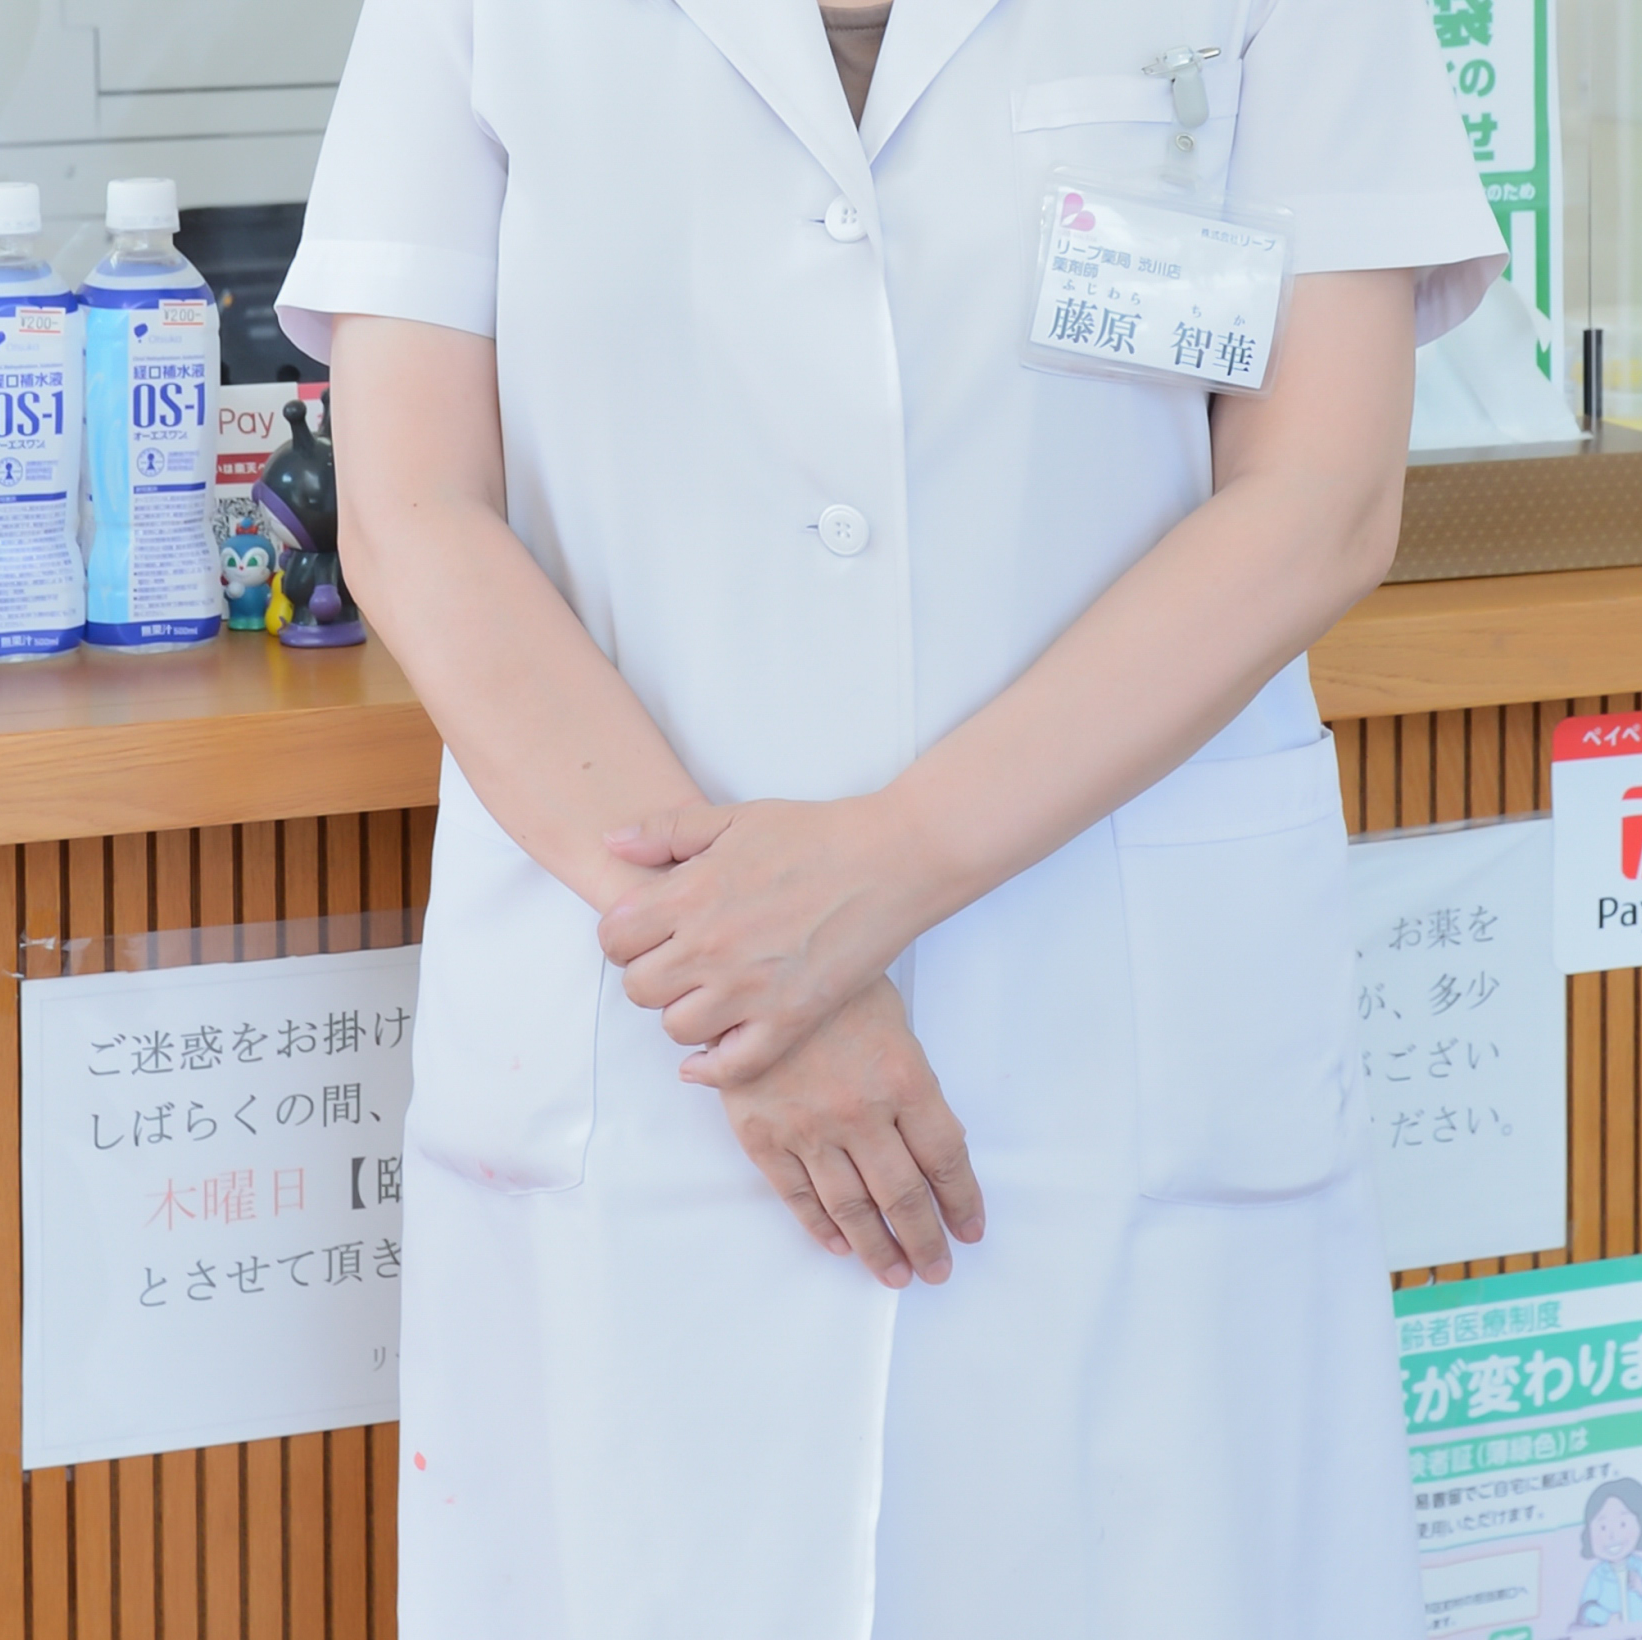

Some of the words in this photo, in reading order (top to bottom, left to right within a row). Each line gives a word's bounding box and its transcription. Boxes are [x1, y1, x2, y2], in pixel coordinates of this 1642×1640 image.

[1446, 58, 1497, 98] の
[1051, 255, 1099, 278] 薬剤師
[1057, 239, 1132, 269] リープ薬局
[1138, 257, 1182, 280] 渋川店
[1048, 297, 1142, 355] 藤原
[1169, 321, 1257, 377] 智華
[133, 364, 205, 380] 経口補水液
[132, 381, 206, 429] OS-1
[218, 407, 275, 439] Pay
[88, 1006, 412, 1077] ご迷惑をお掛け
[90, 1082, 382, 1151] しばらくの間、
[1369, 1104, 1514, 1150] ださい。
[138, 1237, 402, 1308] とさせて頂き
